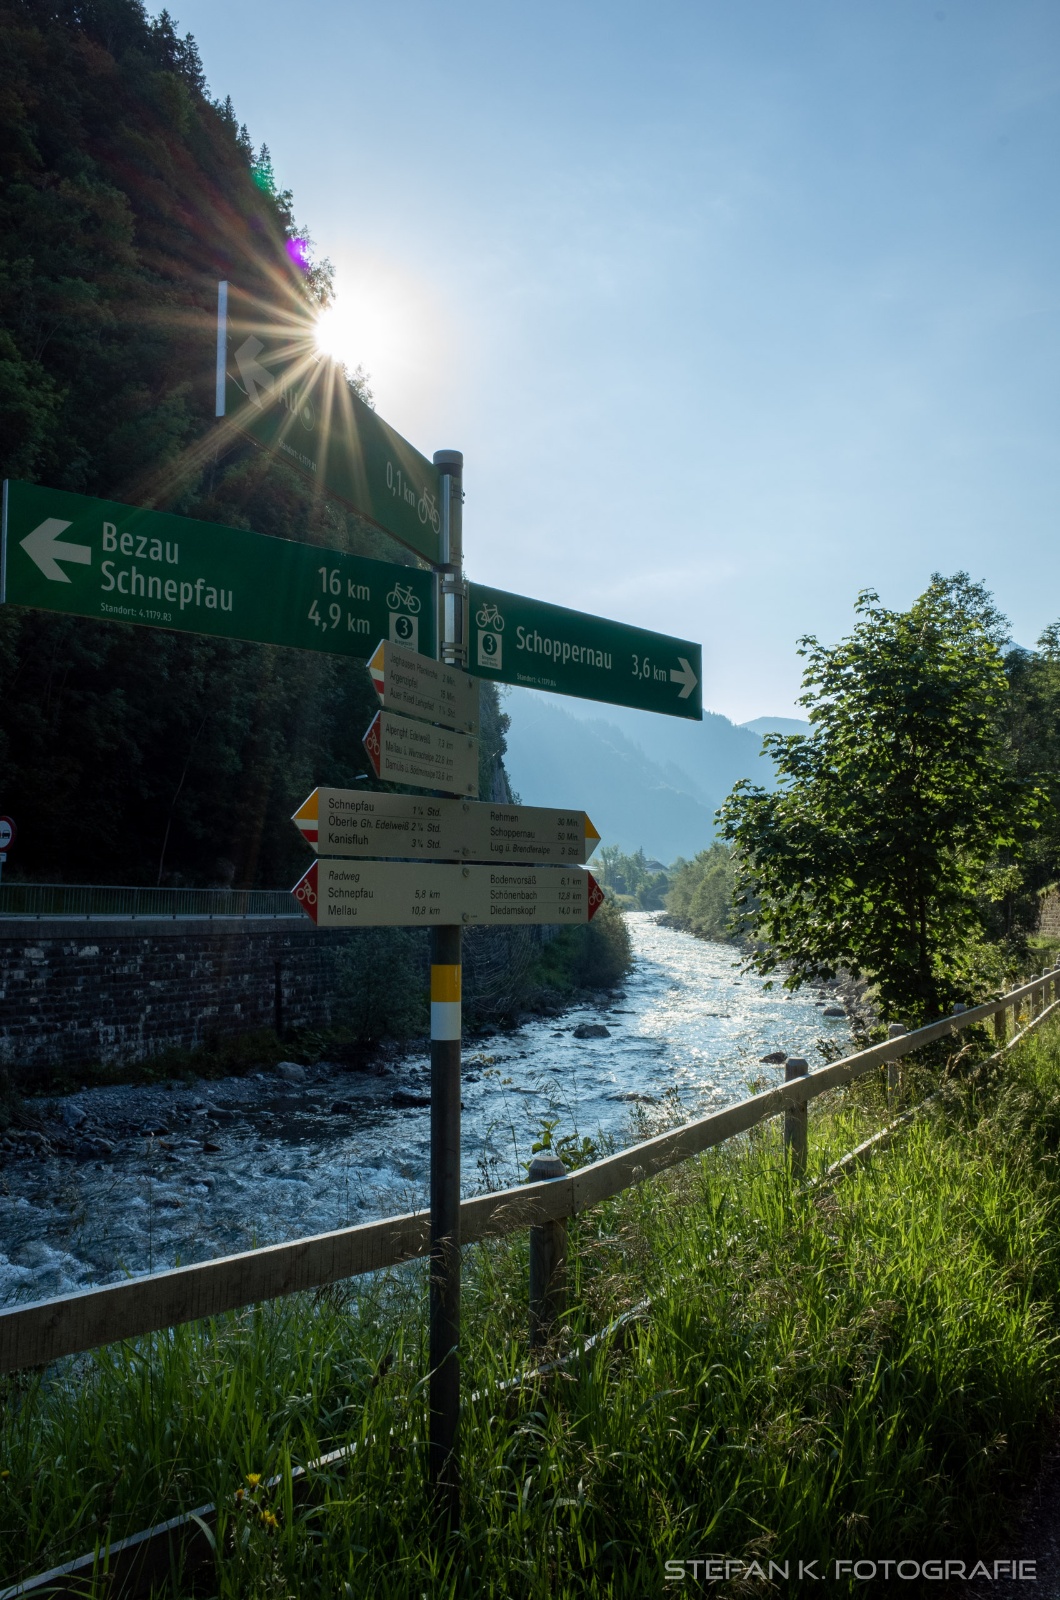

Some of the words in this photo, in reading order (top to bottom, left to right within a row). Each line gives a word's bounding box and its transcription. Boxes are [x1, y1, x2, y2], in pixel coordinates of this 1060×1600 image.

[386, 461, 401, 496] 0,1
[403, 481, 416, 507] km
[102, 522, 179, 565] Bezau
[100, 562, 234, 612] Schnepfau
[318, 567, 342, 596] 16
[348, 578, 370, 601] km
[100, 602, 136, 616] Standort:
[138, 608, 172, 622] 4.1179.R3
[308, 600, 342, 633] 4,9
[348, 612, 370, 635] km
[400, 618, 408, 636] 3
[486, 636, 494, 652] 3
[516, 625, 612, 670] Schoppernau
[632, 654, 650, 680] 3,6
[654, 667, 667, 682] km
[446, 741, 454, 750] km
[446, 756, 454, 766] km
[446, 772, 454, 782] km
[328, 798, 375, 813] Schnepfau
[427, 806, 442, 817] Std.
[328, 812, 358, 828] Öberle
[360, 818, 374, 829] Gh.
[376, 819, 410, 832] Edelweiß
[427, 822, 442, 833] Std.
[490, 812, 519, 823] Rehmen
[566, 818, 580, 828] Min.
[328, 832, 369, 846] Kanisfluh
[427, 838, 442, 849] Std.
[490, 826, 536, 839] Schoppernau
[566, 833, 580, 842] Min.
[490, 842, 504, 853] Lug
[512, 844, 551, 855] Brendleralpe
[561, 847, 565, 856] 3
[568, 847, 580, 857] Std.
[328, 870, 360, 883] Radweg
[490, 874, 537, 886] Bodenvorsäß
[560, 878, 570, 887] 6,1
[572, 878, 582, 886] km
[328, 887, 374, 902] Schnepfau
[414, 890, 426, 900] 5,8
[429, 890, 441, 899] km
[490, 890, 538, 900] Schönenbach
[558, 892, 571, 902] 12,8
[572, 892, 582, 901] km
[328, 904, 358, 916] Mellau
[411, 906, 426, 916] 10,8
[429, 906, 441, 915] km
[490, 905, 537, 917] Diedamskopf
[558, 907, 571, 916] 14,0
[572, 907, 582, 916] km
